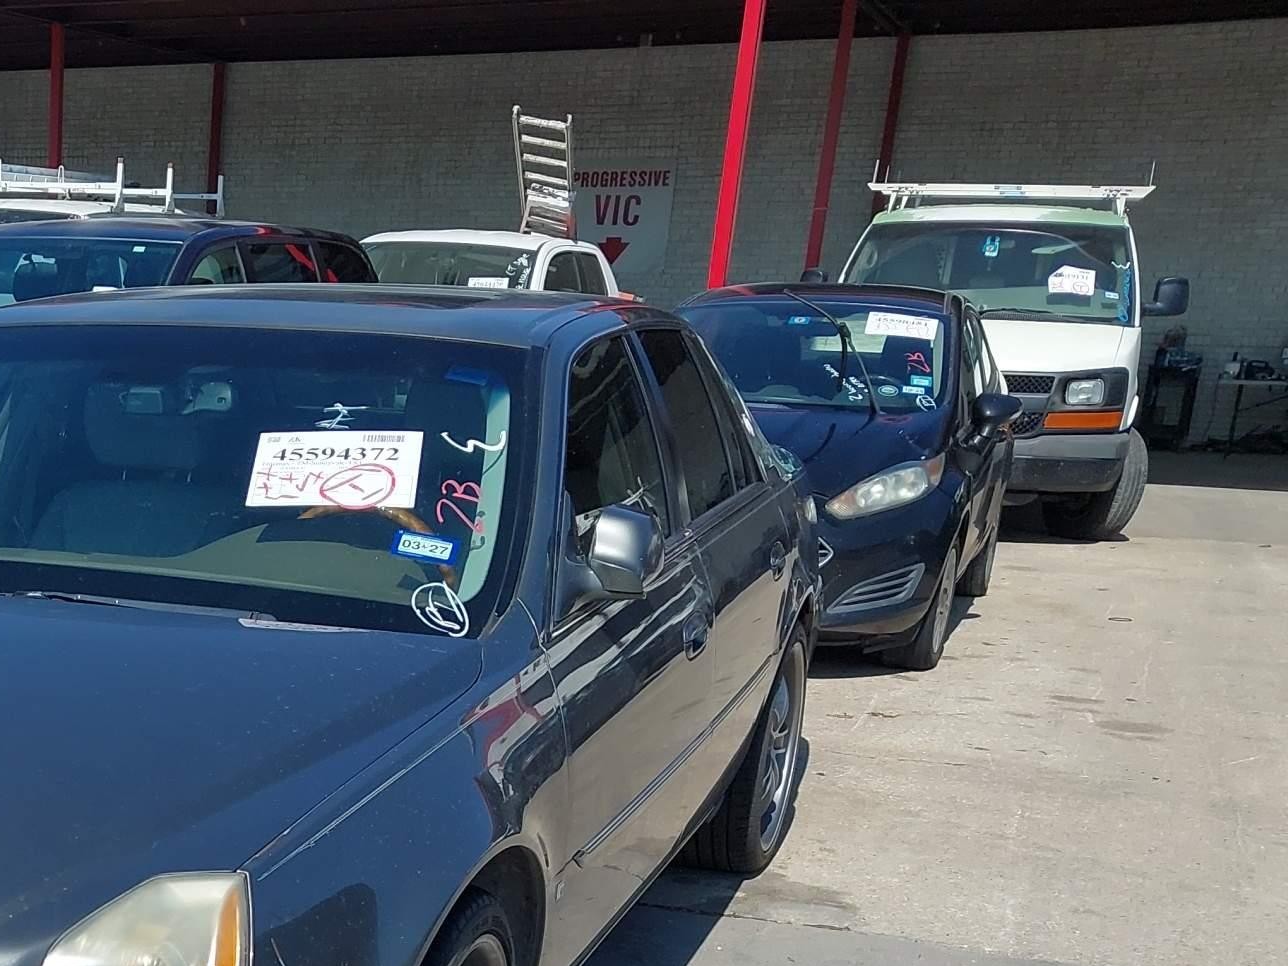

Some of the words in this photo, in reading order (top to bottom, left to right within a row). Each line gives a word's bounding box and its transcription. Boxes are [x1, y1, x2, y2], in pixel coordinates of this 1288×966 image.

[574, 170, 671, 188] PROGRESSIVE
[594, 194, 642, 226] VIC
[272, 447, 400, 461] 45594372
